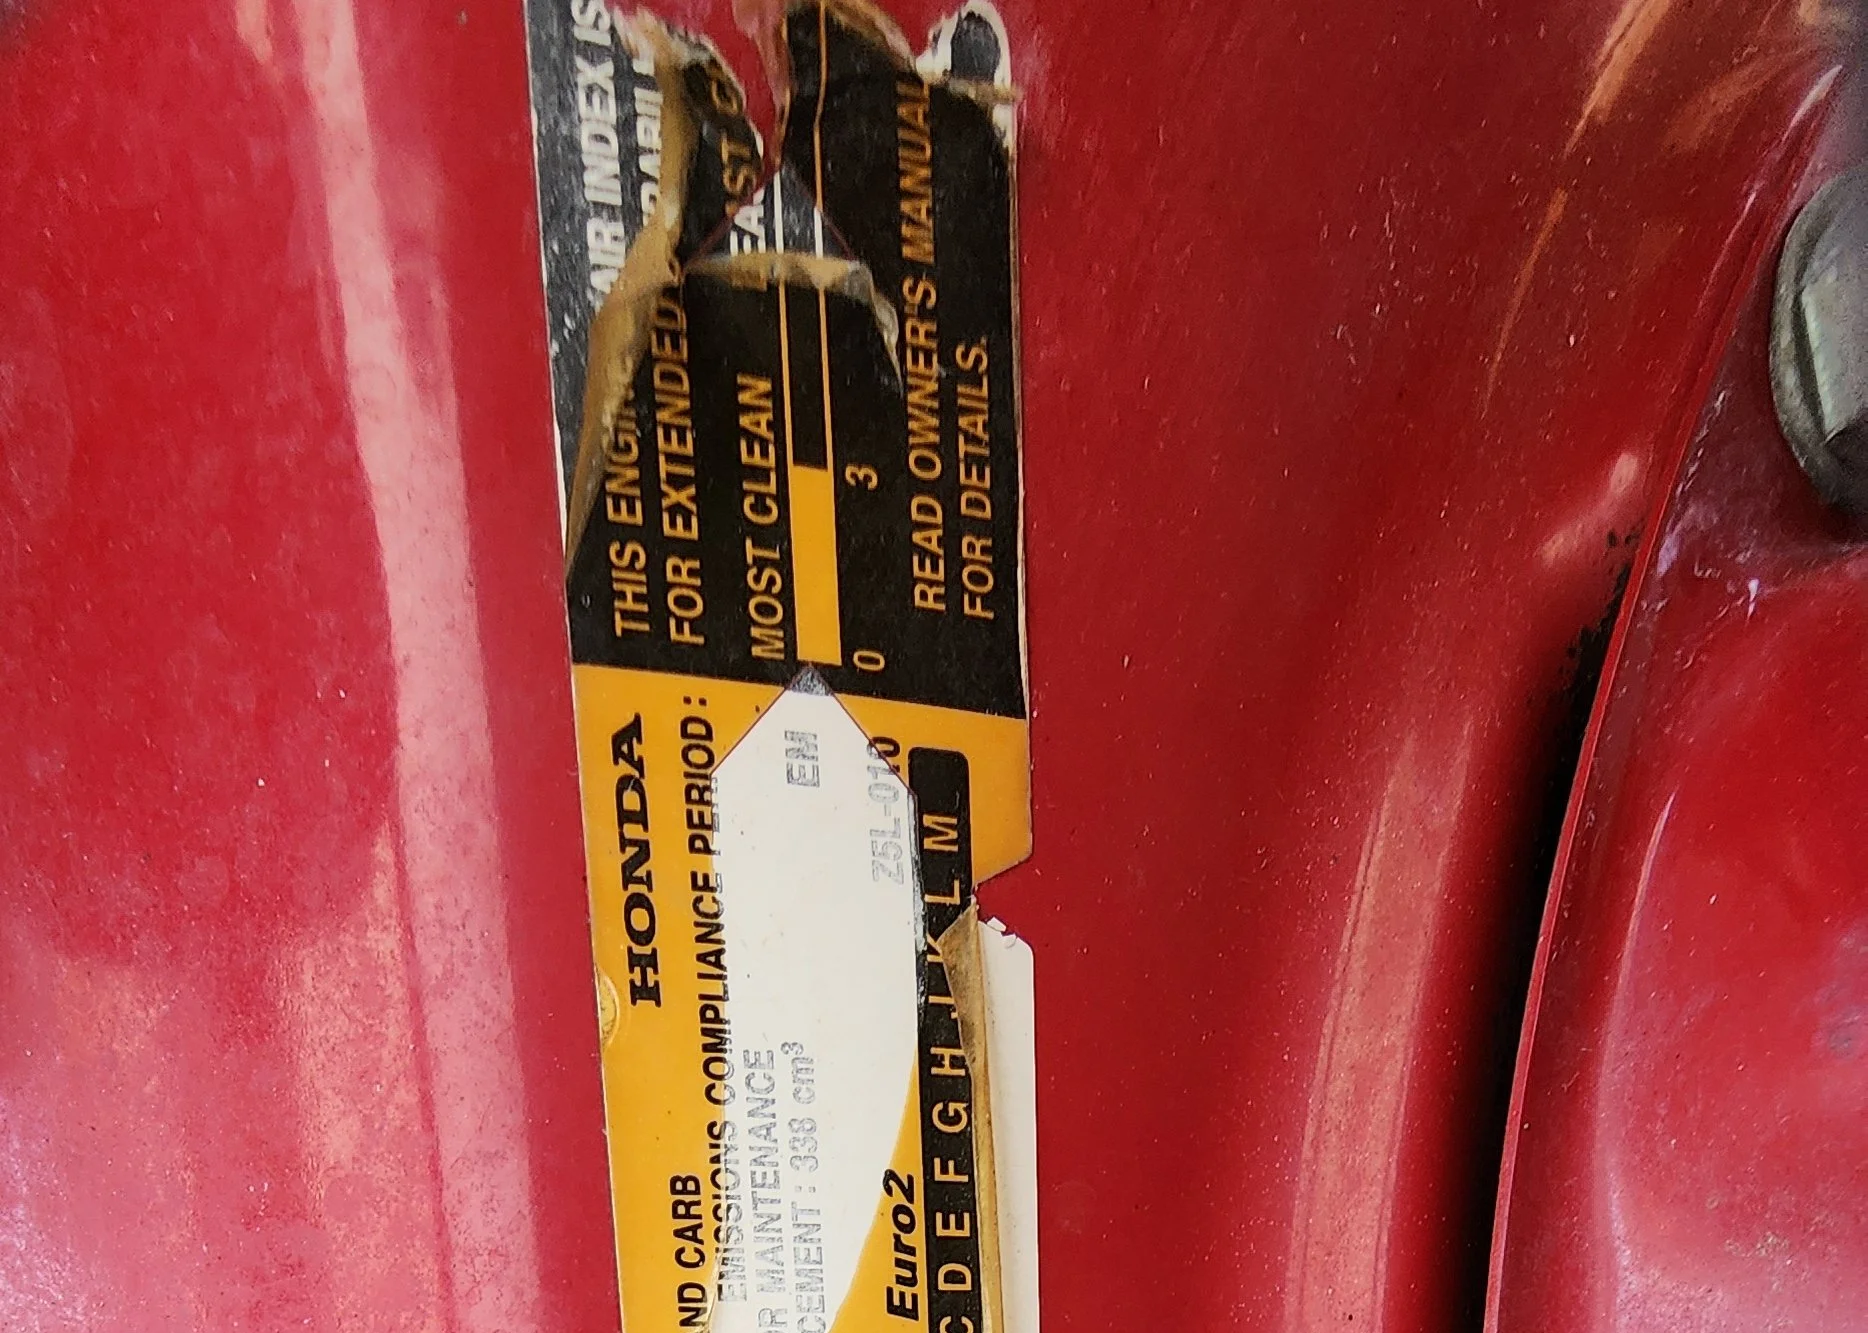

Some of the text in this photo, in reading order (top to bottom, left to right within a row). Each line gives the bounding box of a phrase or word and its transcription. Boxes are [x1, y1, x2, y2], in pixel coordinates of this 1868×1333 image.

[575, 55, 622, 206] INDEX
[897, 80, 946, 612] READ OWNER'S MANUAL
[650, 296, 705, 645] FOR EXTENDED
[737, 372, 786, 659] MOST CLEAN
[955, 335, 994, 619] FOR DETAILS.
[608, 539, 651, 638] THIS
[845, 464, 885, 671] 0 3
[611, 712, 662, 1008] HONDA
[922, 811, 959, 852] M
[923, 879, 961, 906] L
[691, 870, 736, 1106] COMPLIANCE
[930, 1046, 967, 1077] H
[742, 1048, 786, 1293] MAINTENANCE
[931, 1101, 969, 1134] G
[933, 1157, 969, 1183] F
[670, 1174, 706, 1269] CARB
[706, 1119, 748, 1302] EMISSIONS
[882, 1168, 920, 1322] Euro2
[935, 1211, 971, 1238] E
[937, 1262, 973, 1292] D
